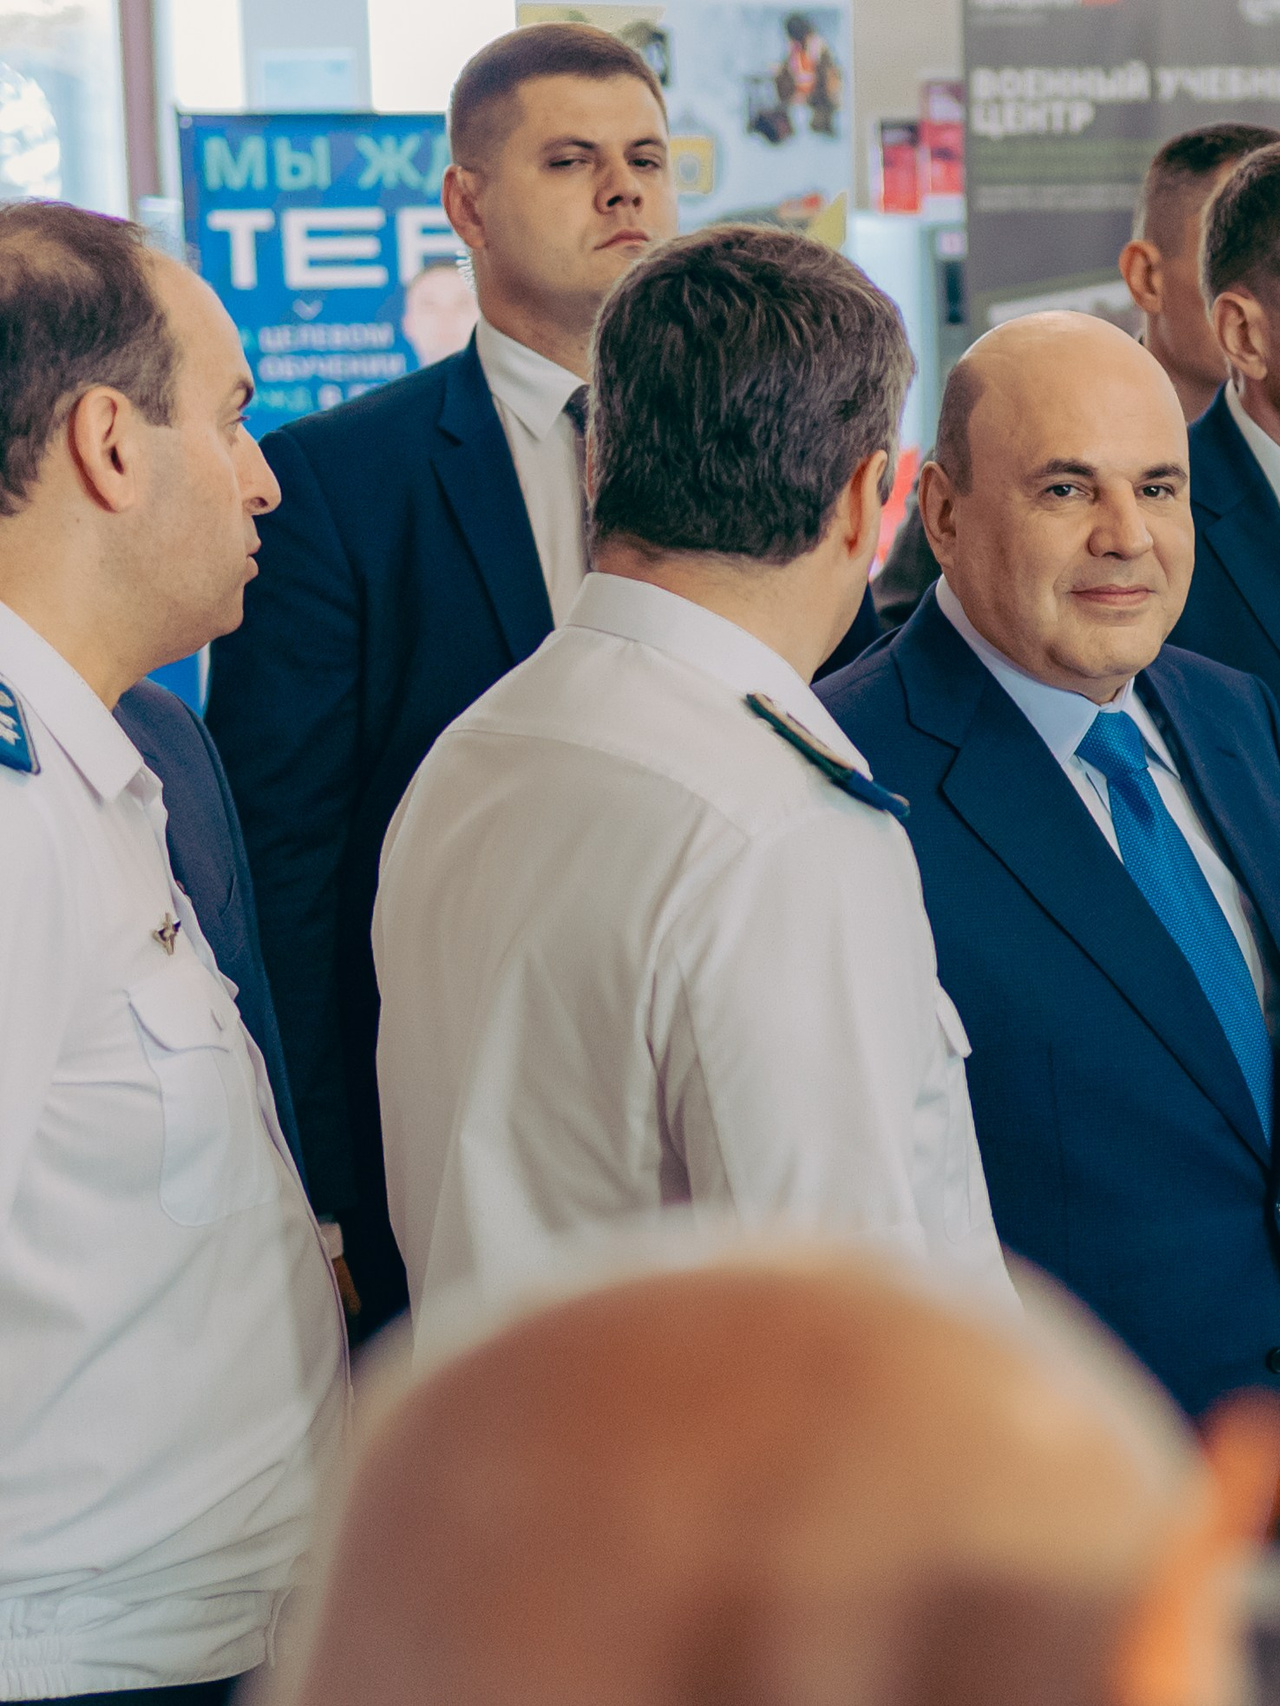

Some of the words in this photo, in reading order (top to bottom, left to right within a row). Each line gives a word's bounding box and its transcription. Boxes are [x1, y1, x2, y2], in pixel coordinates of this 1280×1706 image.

[970, 60, 1151, 100] ВОЕННЫЙ
[970, 99, 1096, 140] ЦЕНТР
[203, 135, 331, 191] МЫ
